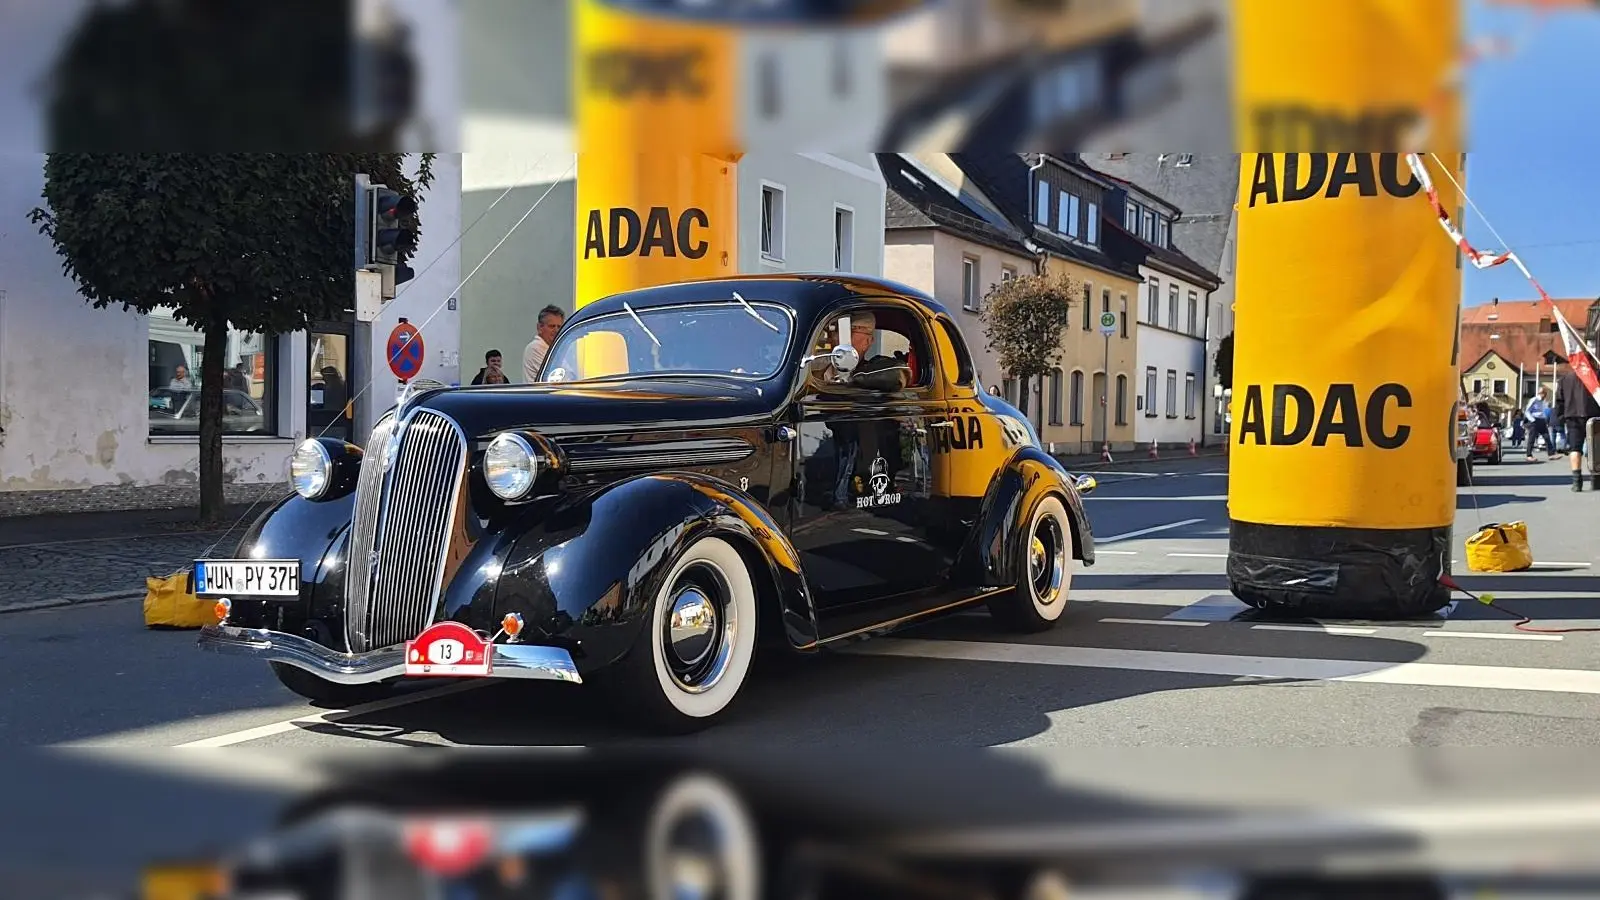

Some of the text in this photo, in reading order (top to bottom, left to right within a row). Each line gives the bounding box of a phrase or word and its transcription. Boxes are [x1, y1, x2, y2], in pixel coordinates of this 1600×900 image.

[584, 207, 710, 259] ADAC
[1239, 383, 1413, 449] ADAC
[856, 493, 902, 509] HOT ROD
[205, 566, 234, 591] WUN
[245, 566, 265, 591] PY
[268, 566, 300, 591] 37H
[440, 644, 453, 660] 13
